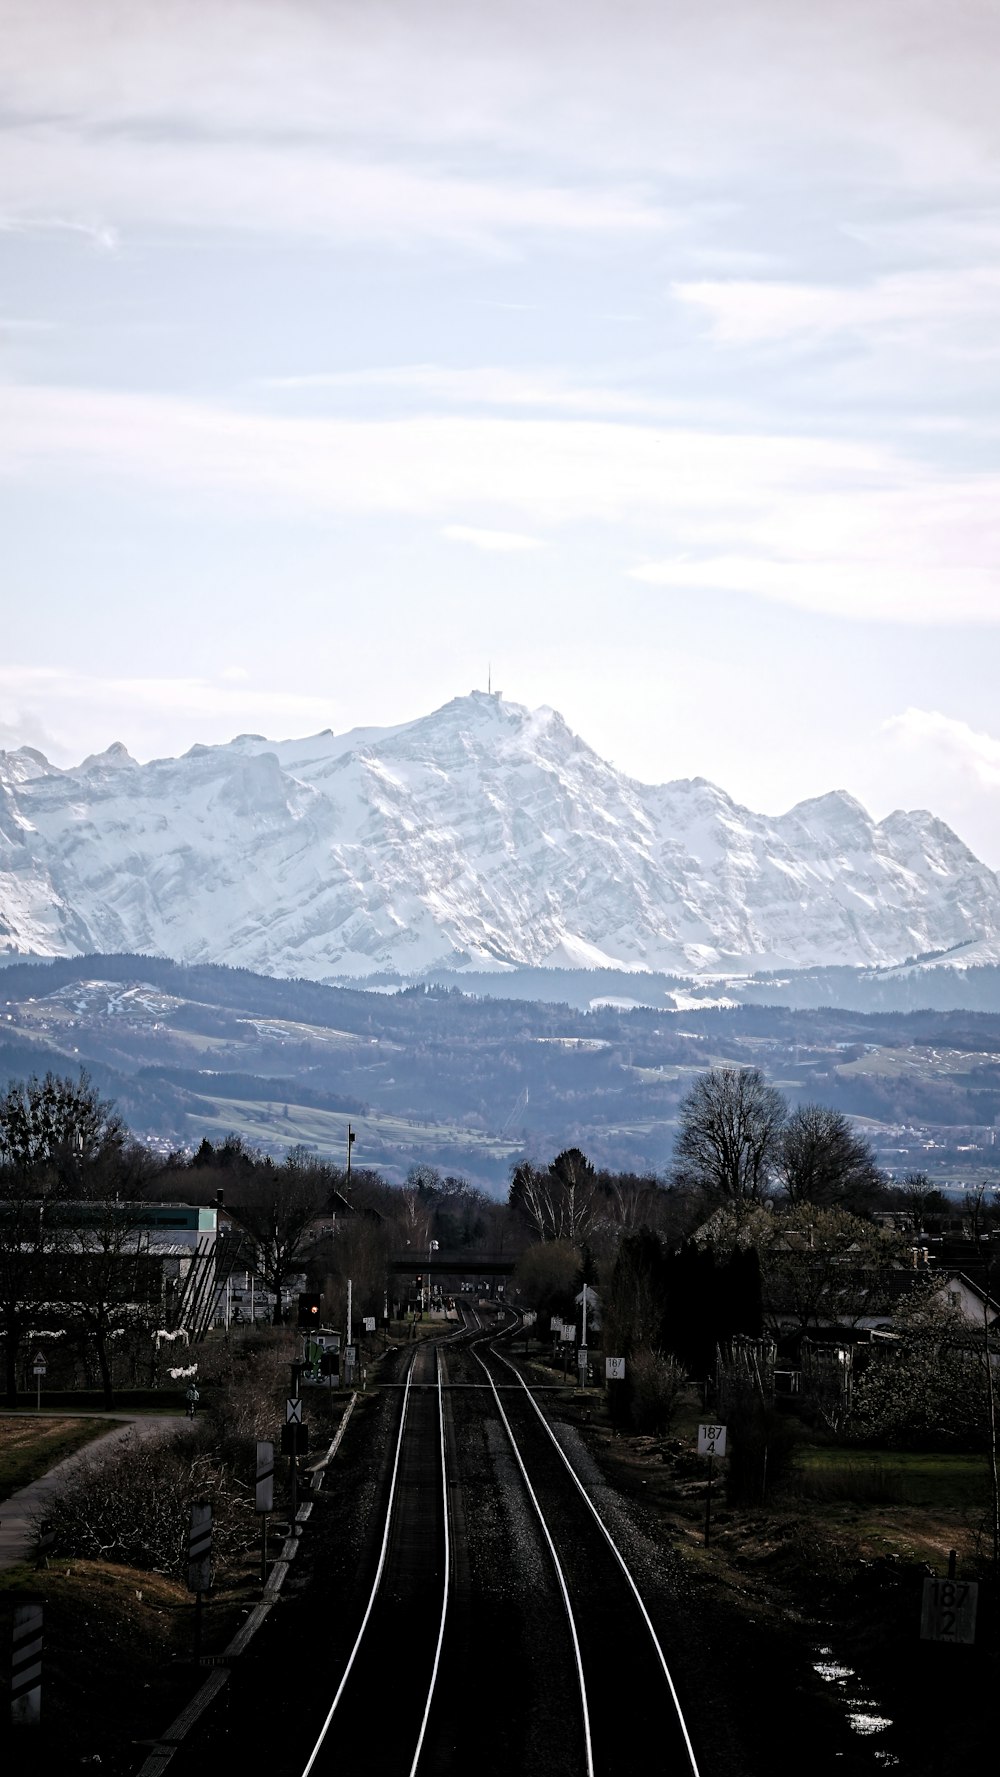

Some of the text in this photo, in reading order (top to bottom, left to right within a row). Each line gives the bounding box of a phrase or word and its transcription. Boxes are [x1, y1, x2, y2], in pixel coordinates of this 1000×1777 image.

[608, 1358, 622, 1367] 187
[612, 1368, 618, 1376] 6
[702, 1427, 722, 1439] 187
[706, 1441, 715, 1453] 4
[932, 1584, 969, 1608] 187
[940, 1610, 956, 1635] 2
